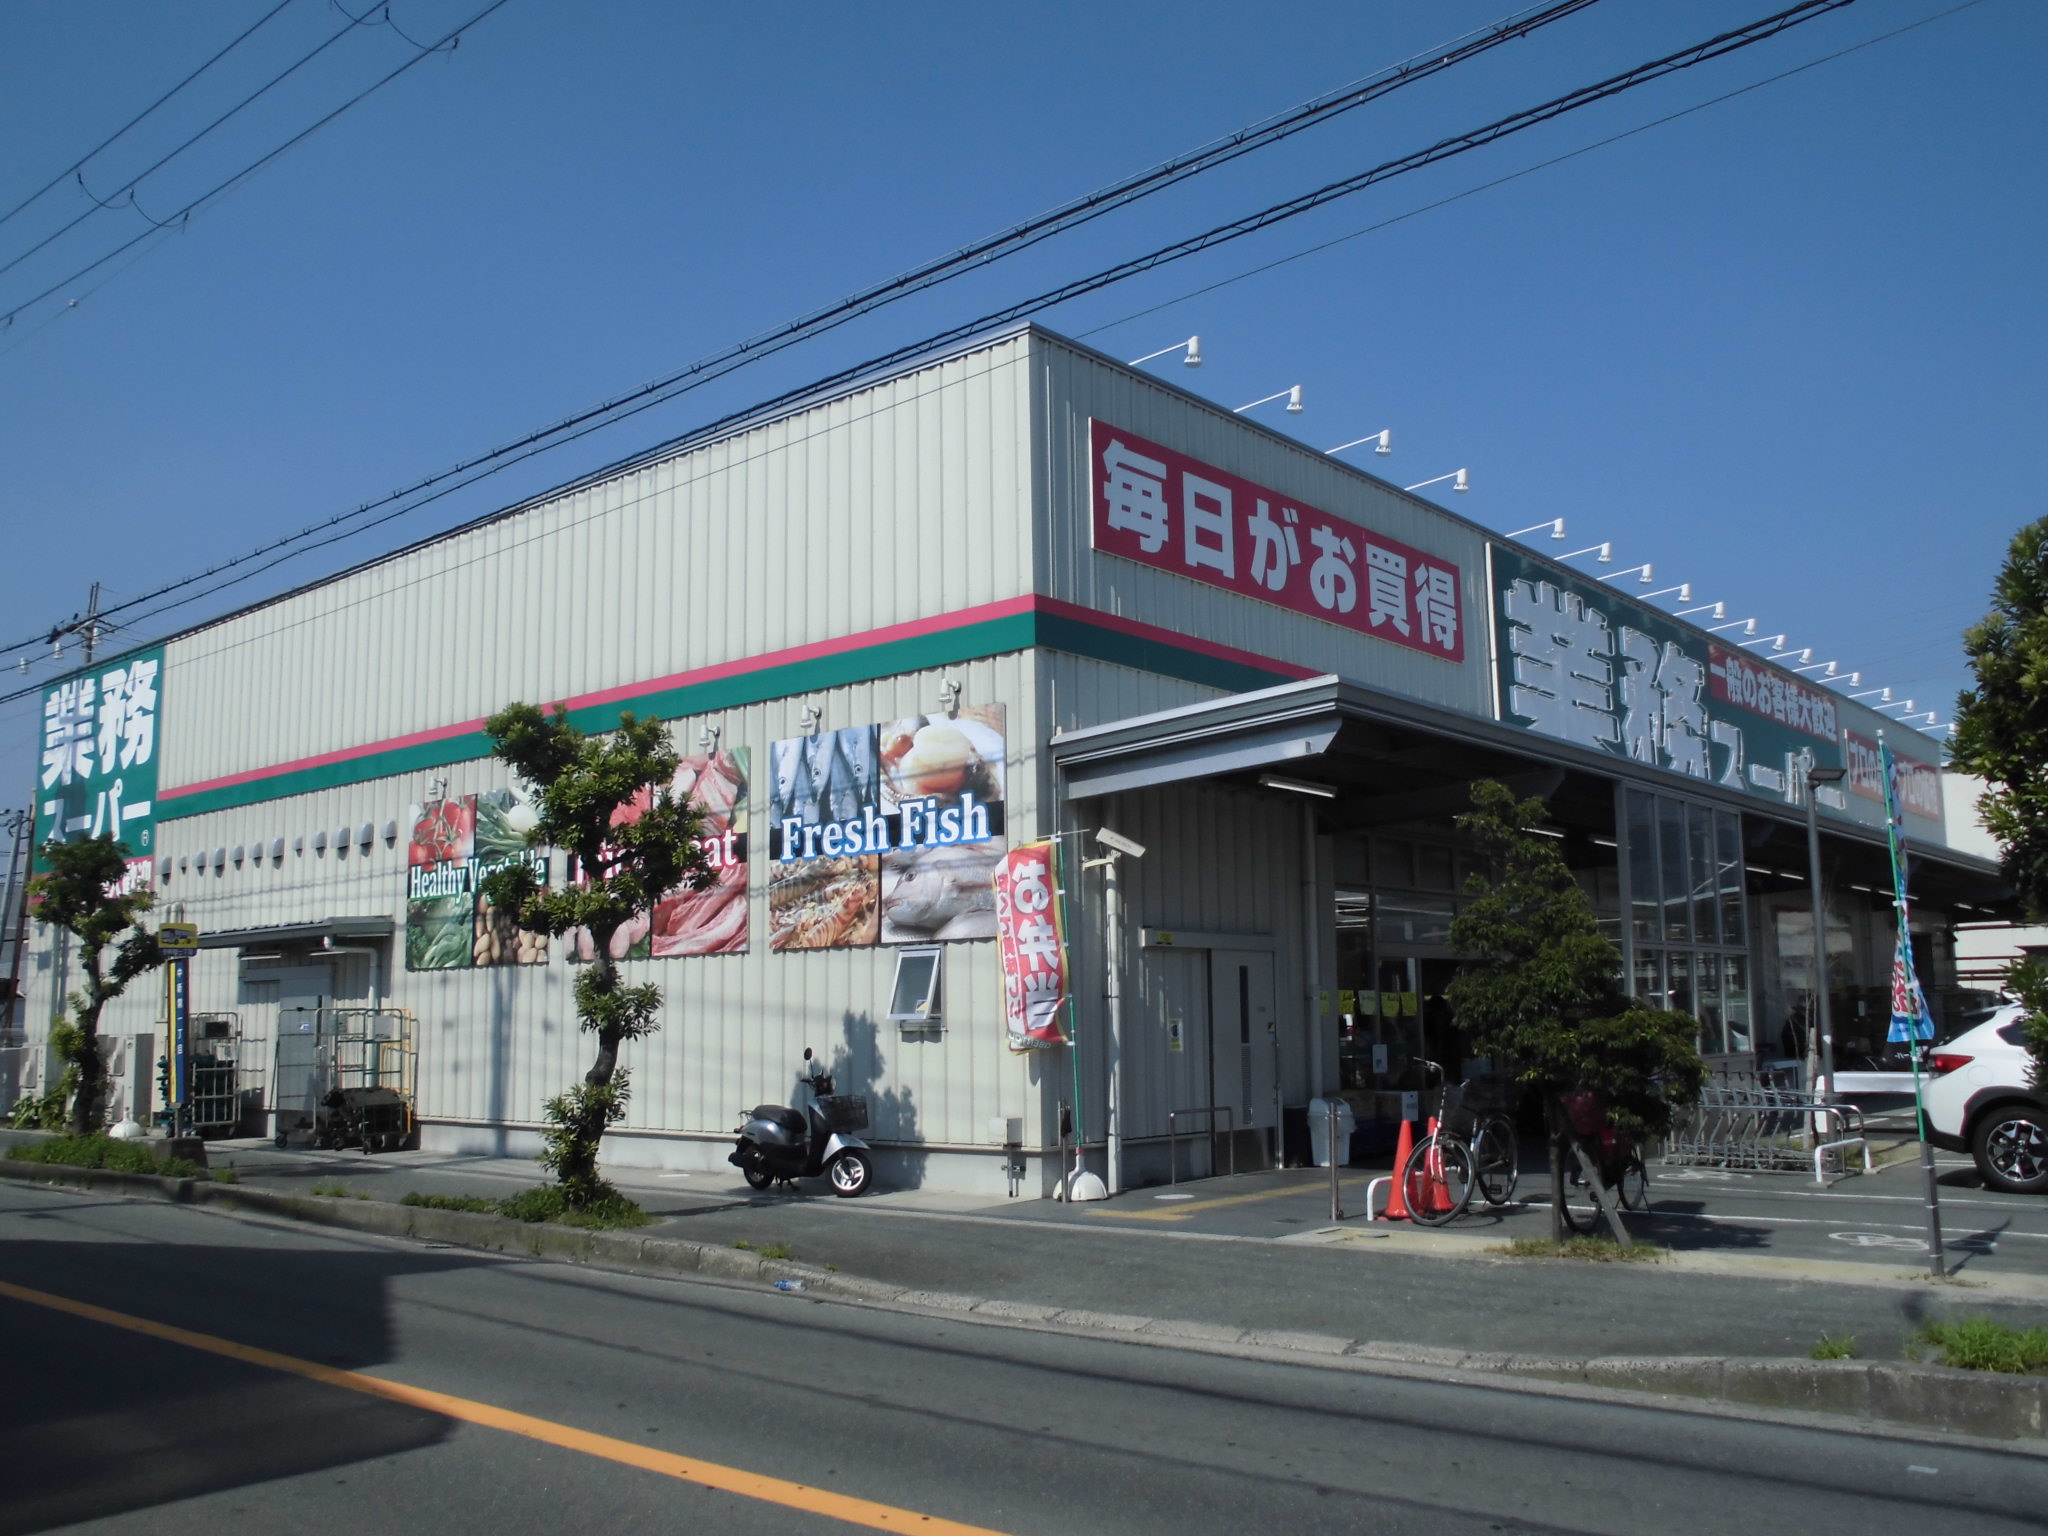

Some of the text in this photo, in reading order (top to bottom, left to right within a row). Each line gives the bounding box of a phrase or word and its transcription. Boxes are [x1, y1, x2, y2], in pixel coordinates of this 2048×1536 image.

[1102, 439, 1458, 652] 毎日がお買得
[41, 659, 158, 790] 業務
[1710, 656, 1837, 742] 一般のお客様大歓迎
[43, 778, 151, 845] スーパー
[782, 793, 990, 861] Fresh Fish
[410, 860, 467, 904] Healthy
